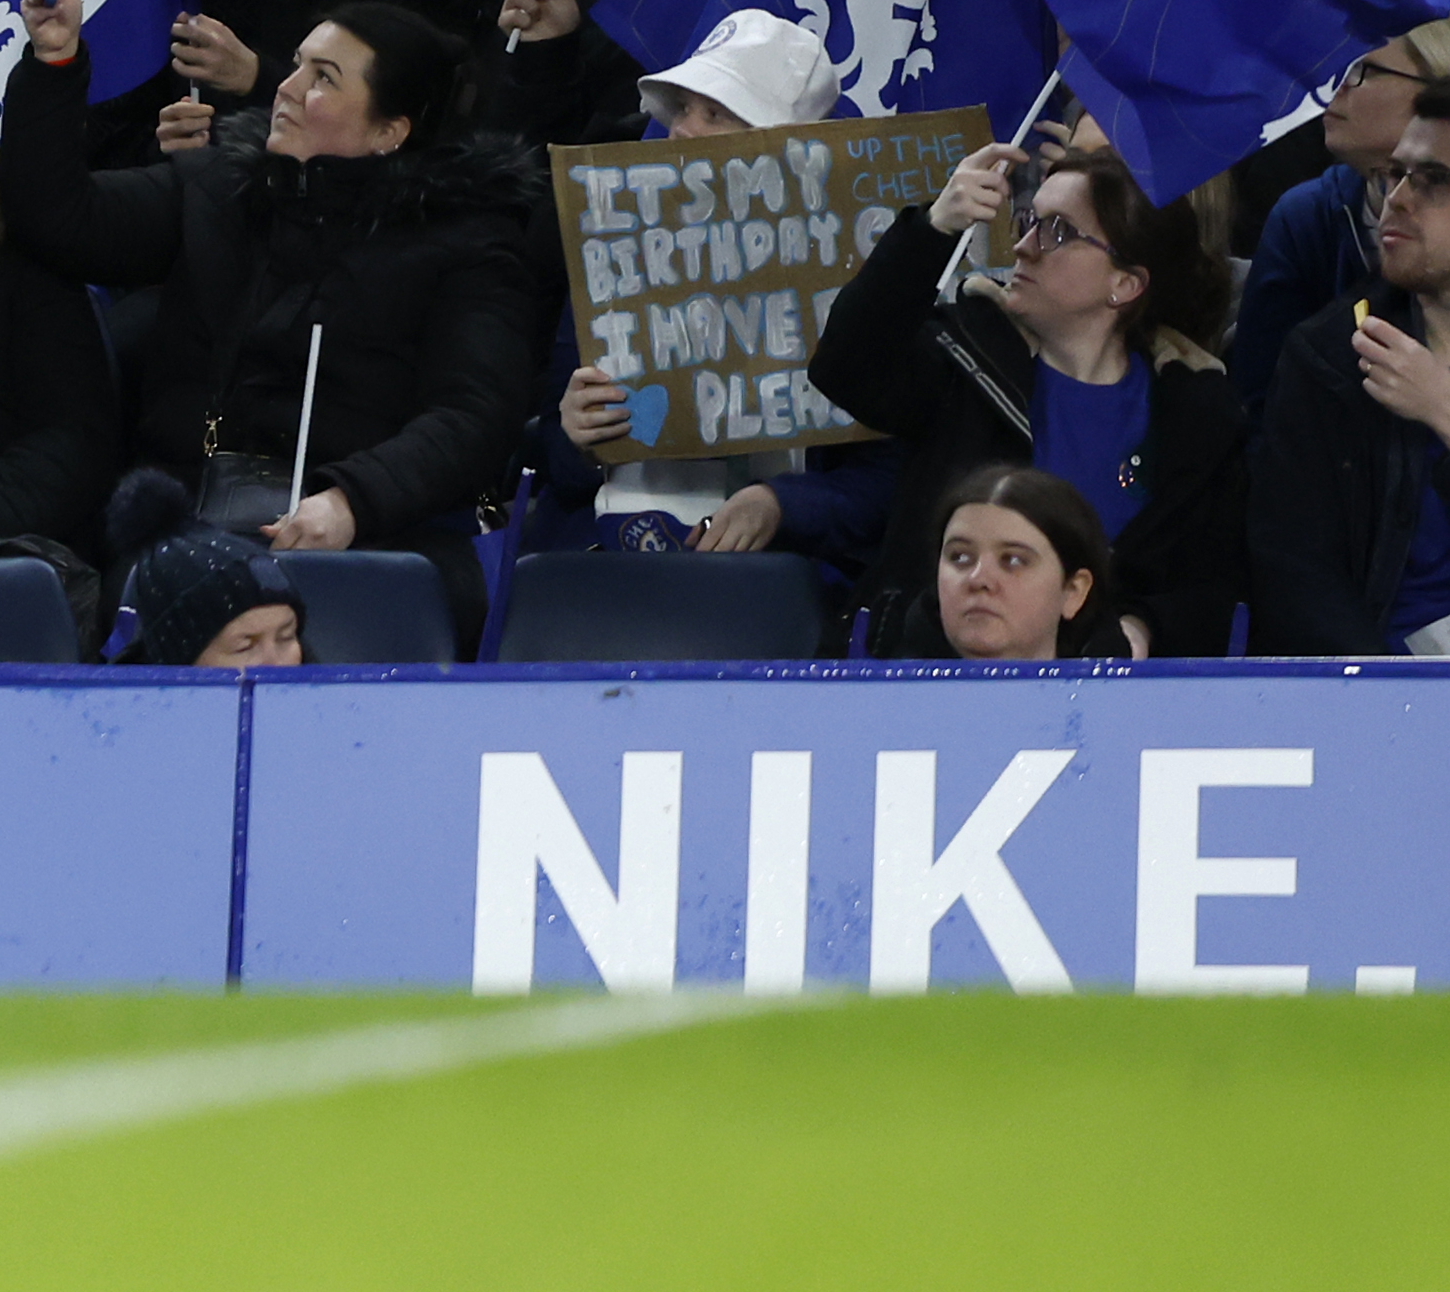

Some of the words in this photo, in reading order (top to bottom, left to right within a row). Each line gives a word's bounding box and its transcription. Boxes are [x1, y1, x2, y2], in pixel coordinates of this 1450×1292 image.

[722, 136, 833, 224] MY
[846, 138, 881, 161] UP
[889, 134, 966, 159] THE
[592, 308, 646, 379] I
[649, 289, 806, 372] HAVE
